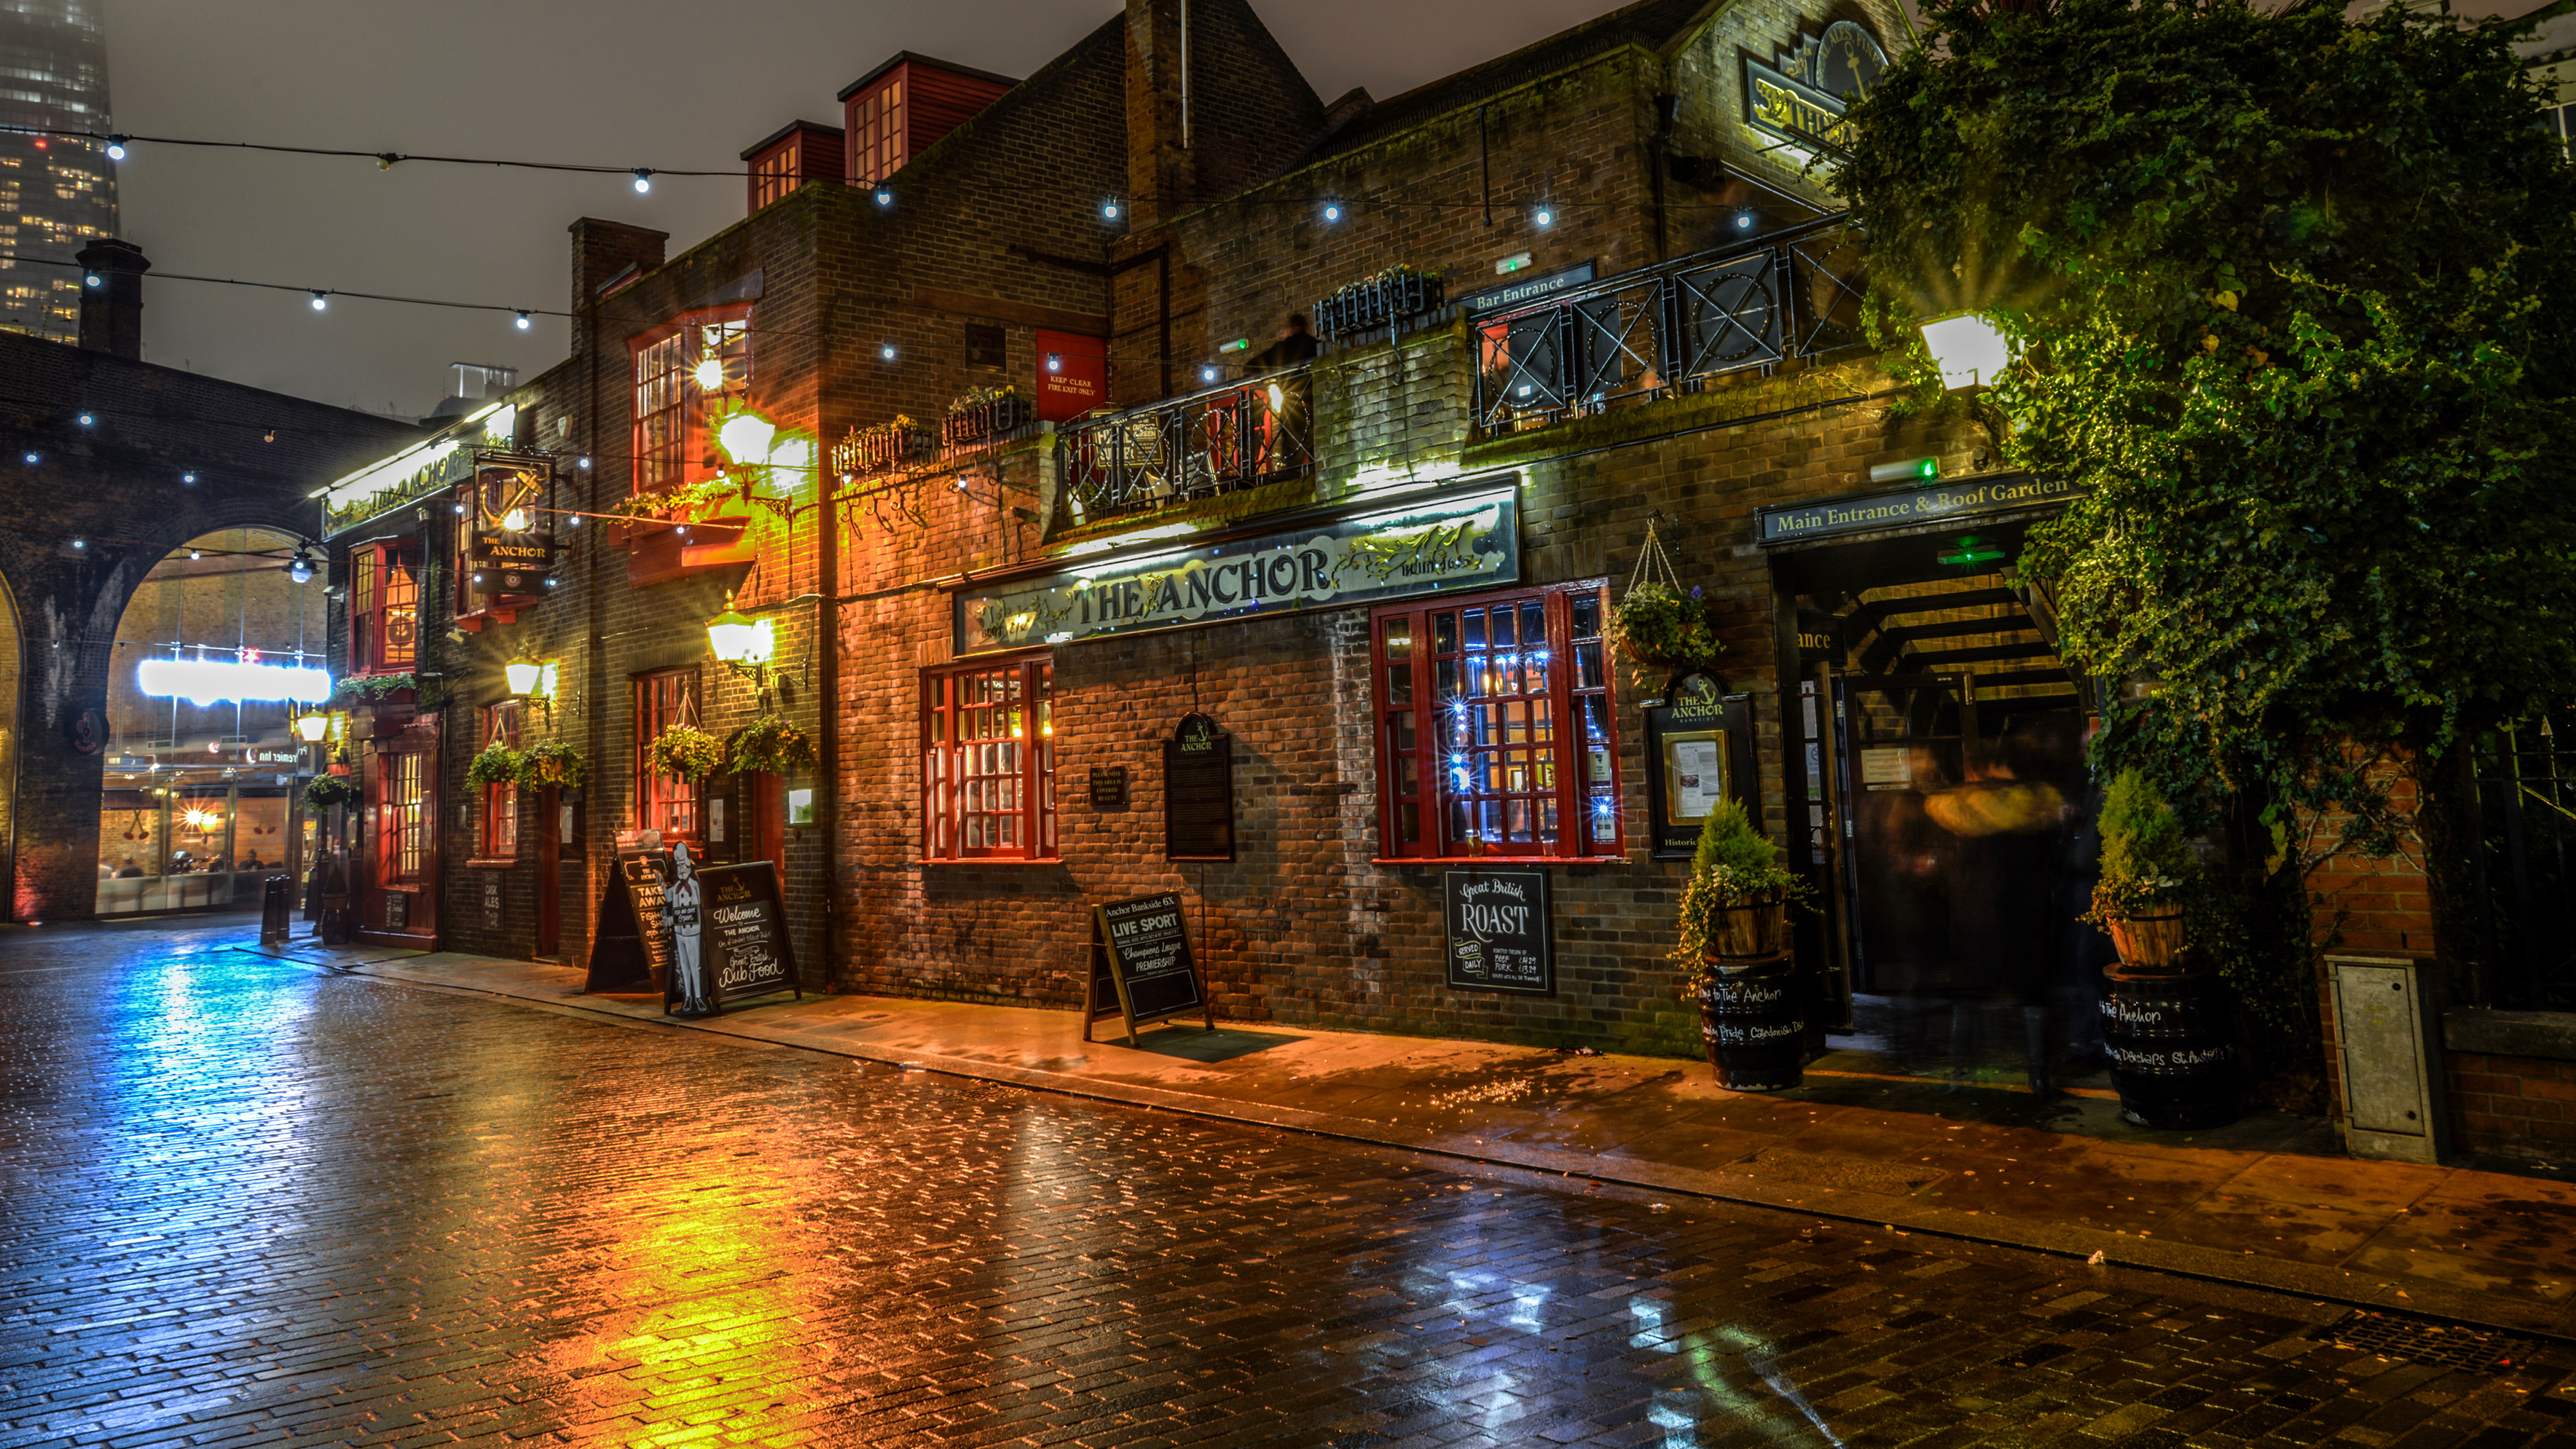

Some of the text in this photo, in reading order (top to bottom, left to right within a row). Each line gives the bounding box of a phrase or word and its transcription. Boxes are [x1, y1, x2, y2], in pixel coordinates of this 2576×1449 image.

[1856, 32, 1880, 67] FINE
[1477, 278, 1564, 310] Bar Entrance
[1051, 376, 1092, 388] KEEP CLEAR
[1048, 384, 1062, 392] FIRE
[1063, 386, 1077, 394] EXIT
[1777, 476, 2070, 533] Main Entrance & Roof Garden
[482, 537, 500, 545] THE
[490, 545, 546, 558] ANCHOR
[1073, 547, 1332, 625] THE ANCHOR
[1678, 696, 1700, 706] THE
[1672, 704, 1723, 718] ANCHOR
[1181, 742, 1212, 752] ANCHOR
[1665, 839, 1697, 847] Historic
[485, 885, 498, 896] CASK
[638, 885, 663, 897] TAKE
[719, 885, 736, 894] THE
[1459, 878, 1526, 903] Great British
[484, 897, 500, 909] ALES
[716, 890, 752, 903] ANCHOR
[1106, 896, 1175, 918] Anchor Bankside 6X
[678, 914, 694, 923] Open
[713, 905, 761, 924] Welcome
[1112, 912, 1177, 938] LIVE SPORT
[1460, 904, 1529, 943] ROAST
[724, 925, 760, 936] THE ANCHOR
[1122, 941, 1181, 961] Champions League
[1458, 944, 1479, 956] SERVED
[729, 955, 749, 971] Great
[749, 948, 771, 965] British
[1136, 956, 1176, 973] PREMIERSHIP
[1465, 959, 1483, 969] DAILY
[1495, 955, 1510, 963] BEEF
[718, 957, 785, 988] Pub Food
[1495, 963, 1513, 972] PORK
[1713, 987, 1721, 1001] to
[1720, 988, 1738, 1003] The
[1743, 987, 1782, 1003] Anchor
[2105, 1002, 2117, 1018] The
[2119, 1003, 2161, 1024] Anchor
[1718, 1025, 1745, 1039] Pride
[1750, 1025, 1793, 1038] Caledonian
